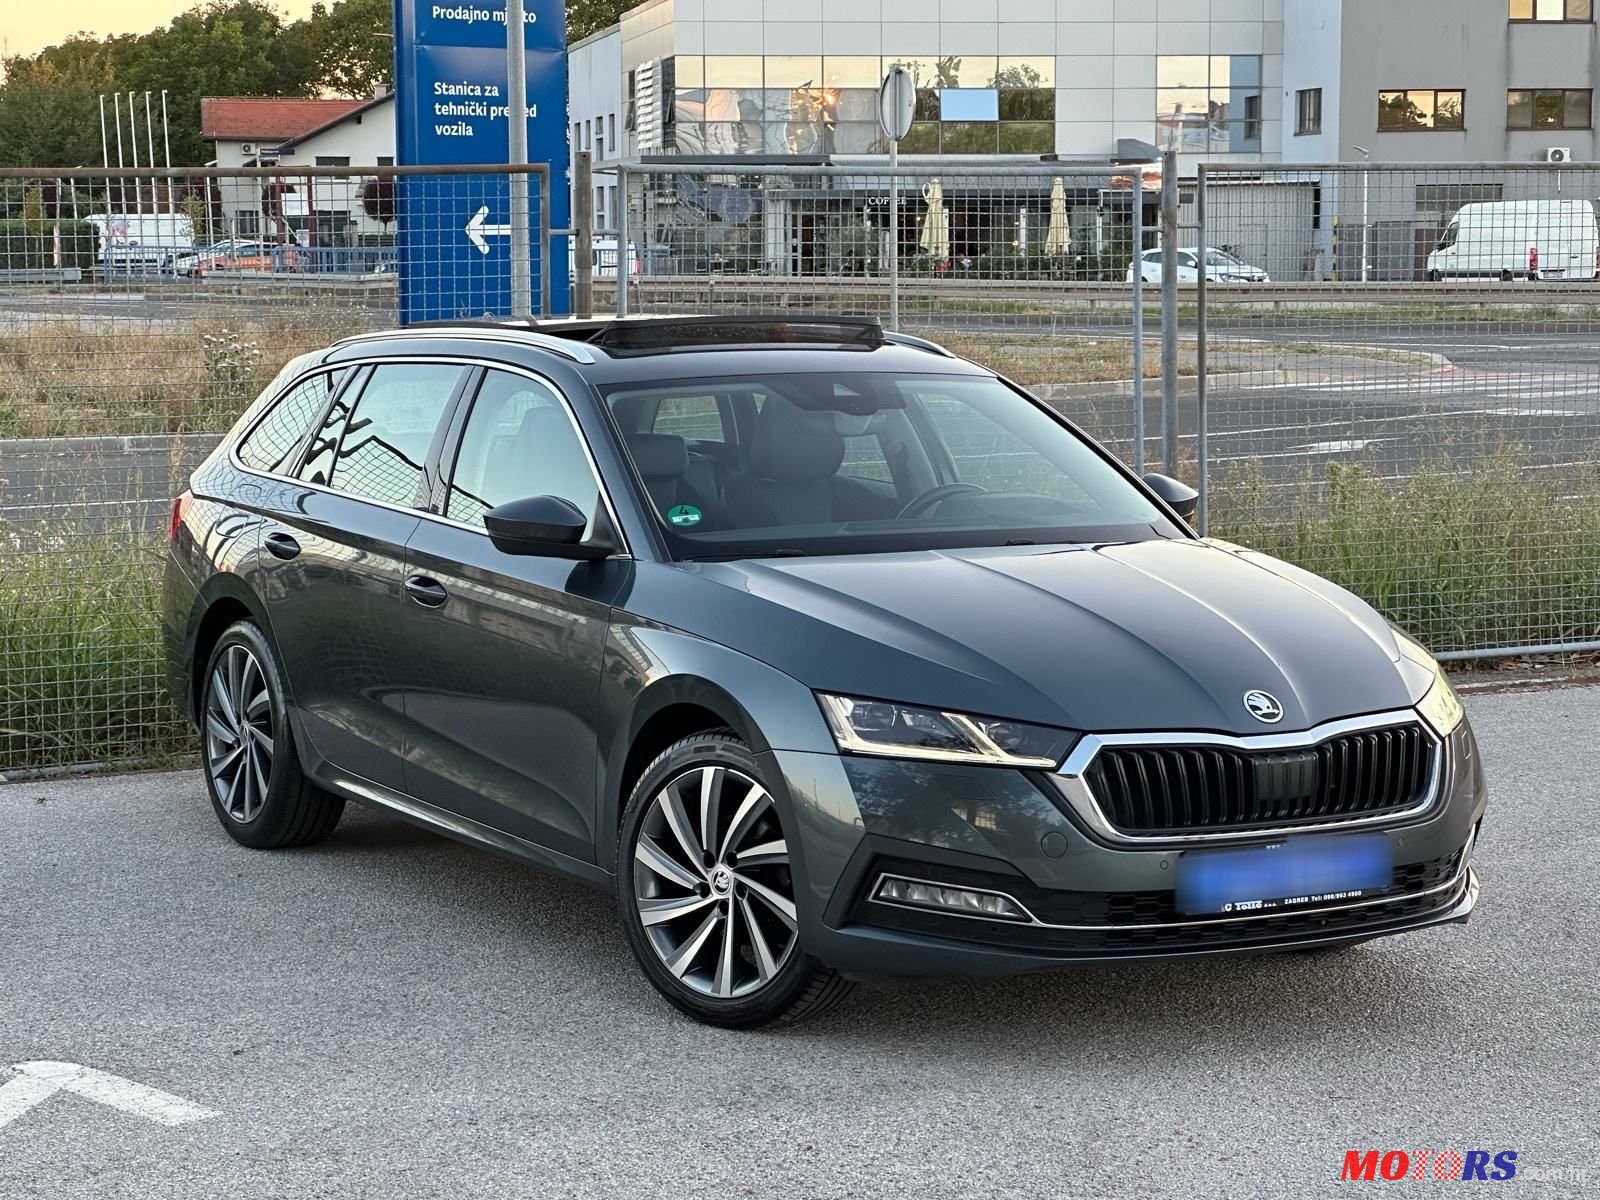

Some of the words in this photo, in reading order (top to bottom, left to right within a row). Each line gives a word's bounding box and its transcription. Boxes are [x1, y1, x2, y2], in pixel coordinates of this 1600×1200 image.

[432, 5, 490, 24] Prodajno
[492, 8, 537, 26] mjto
[434, 81, 481, 96] Stanica
[484, 86, 500, 97] za
[434, 101, 487, 117] tehnički
[435, 121, 474, 136] vozila
[868, 197, 907, 205] COFEE
[1284, 897, 1309, 905] ZAGREB
